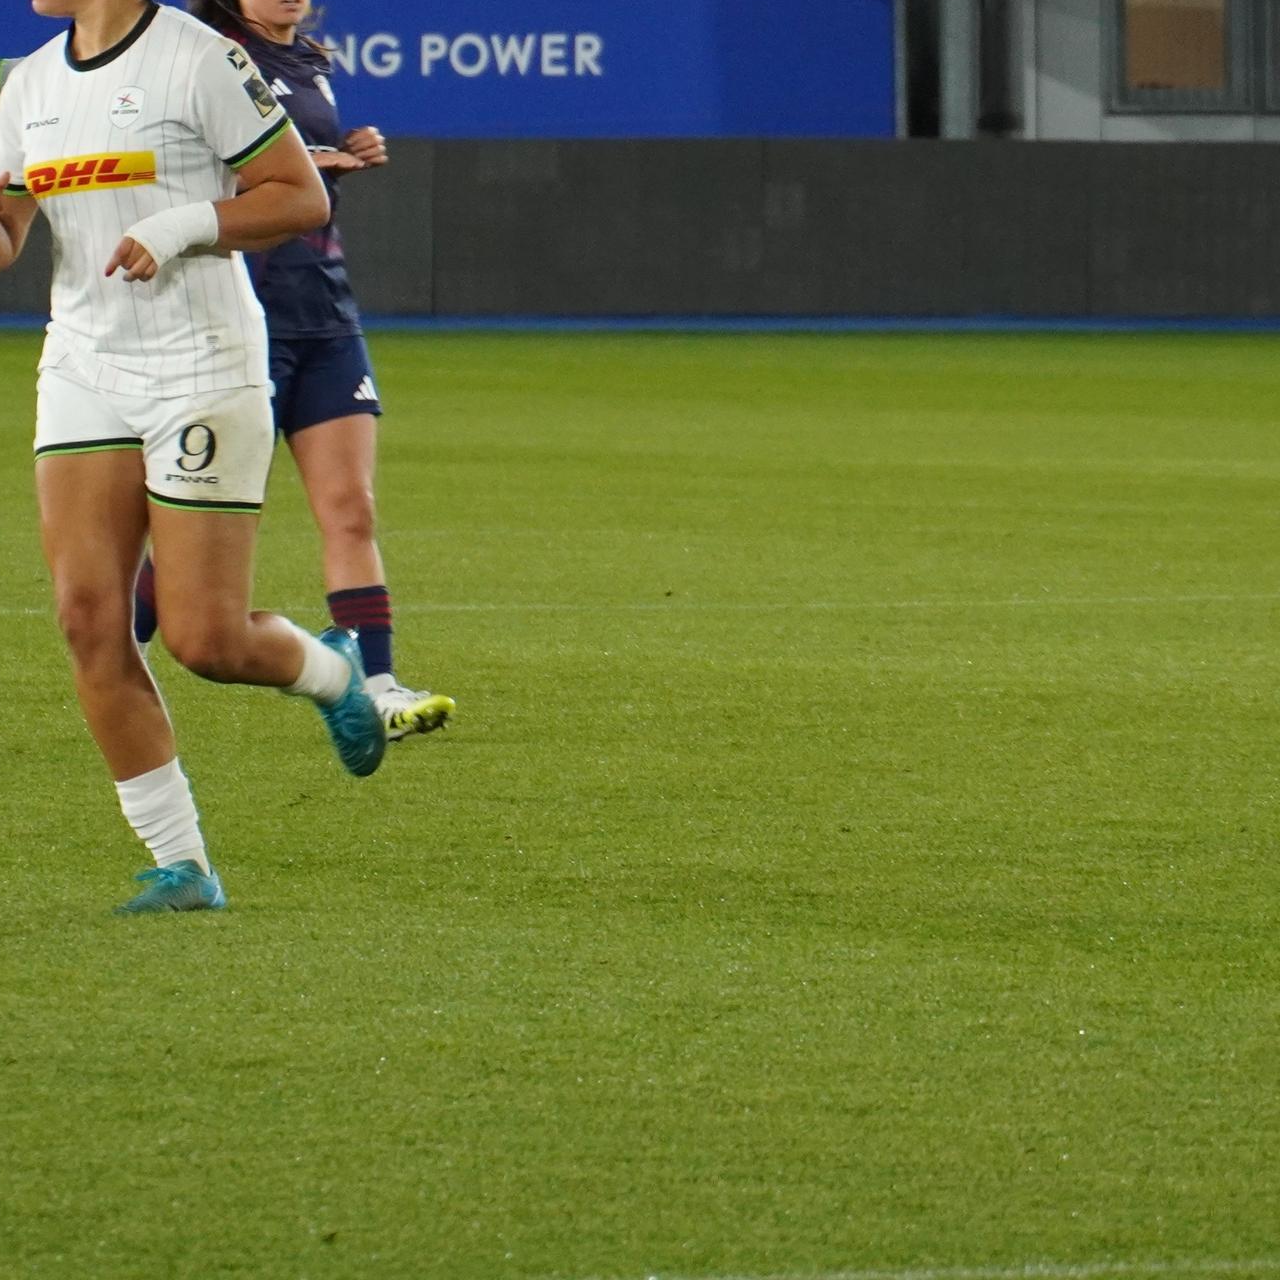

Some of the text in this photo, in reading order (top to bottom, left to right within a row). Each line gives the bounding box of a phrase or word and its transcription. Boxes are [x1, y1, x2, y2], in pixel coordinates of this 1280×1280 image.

[421, 32, 603, 78] POWER
[27, 158, 131, 194] DHL
[176, 424, 216, 472] 9
